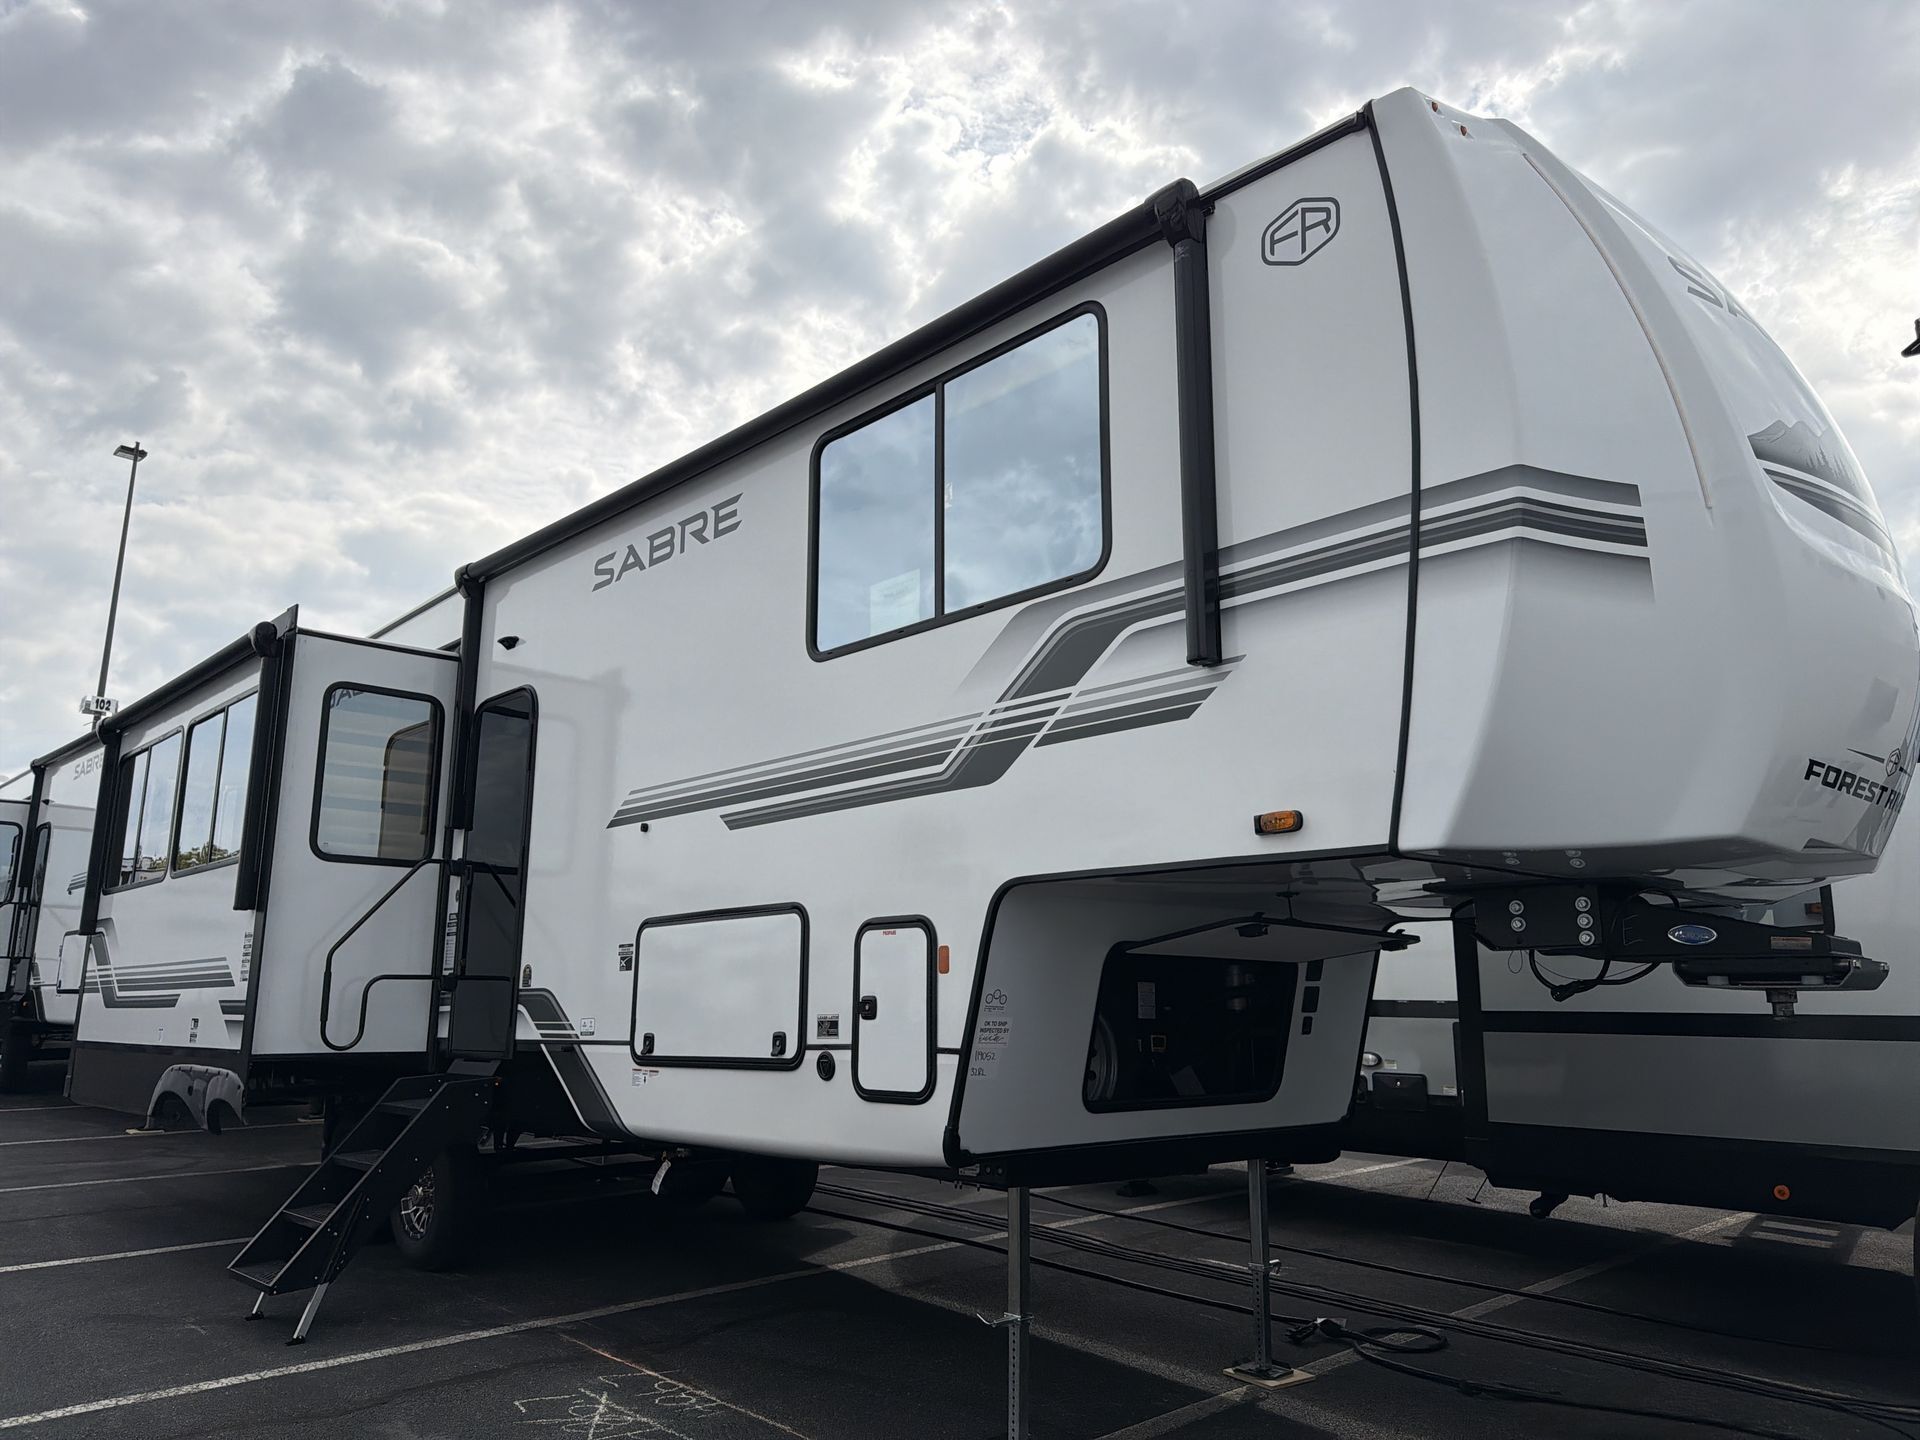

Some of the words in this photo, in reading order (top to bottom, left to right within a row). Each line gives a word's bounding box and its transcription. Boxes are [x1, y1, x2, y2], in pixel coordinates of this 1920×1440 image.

[592, 492, 743, 592] SABRE
[95, 698, 111, 711] 102
[1804, 758, 1888, 805] FOREST
